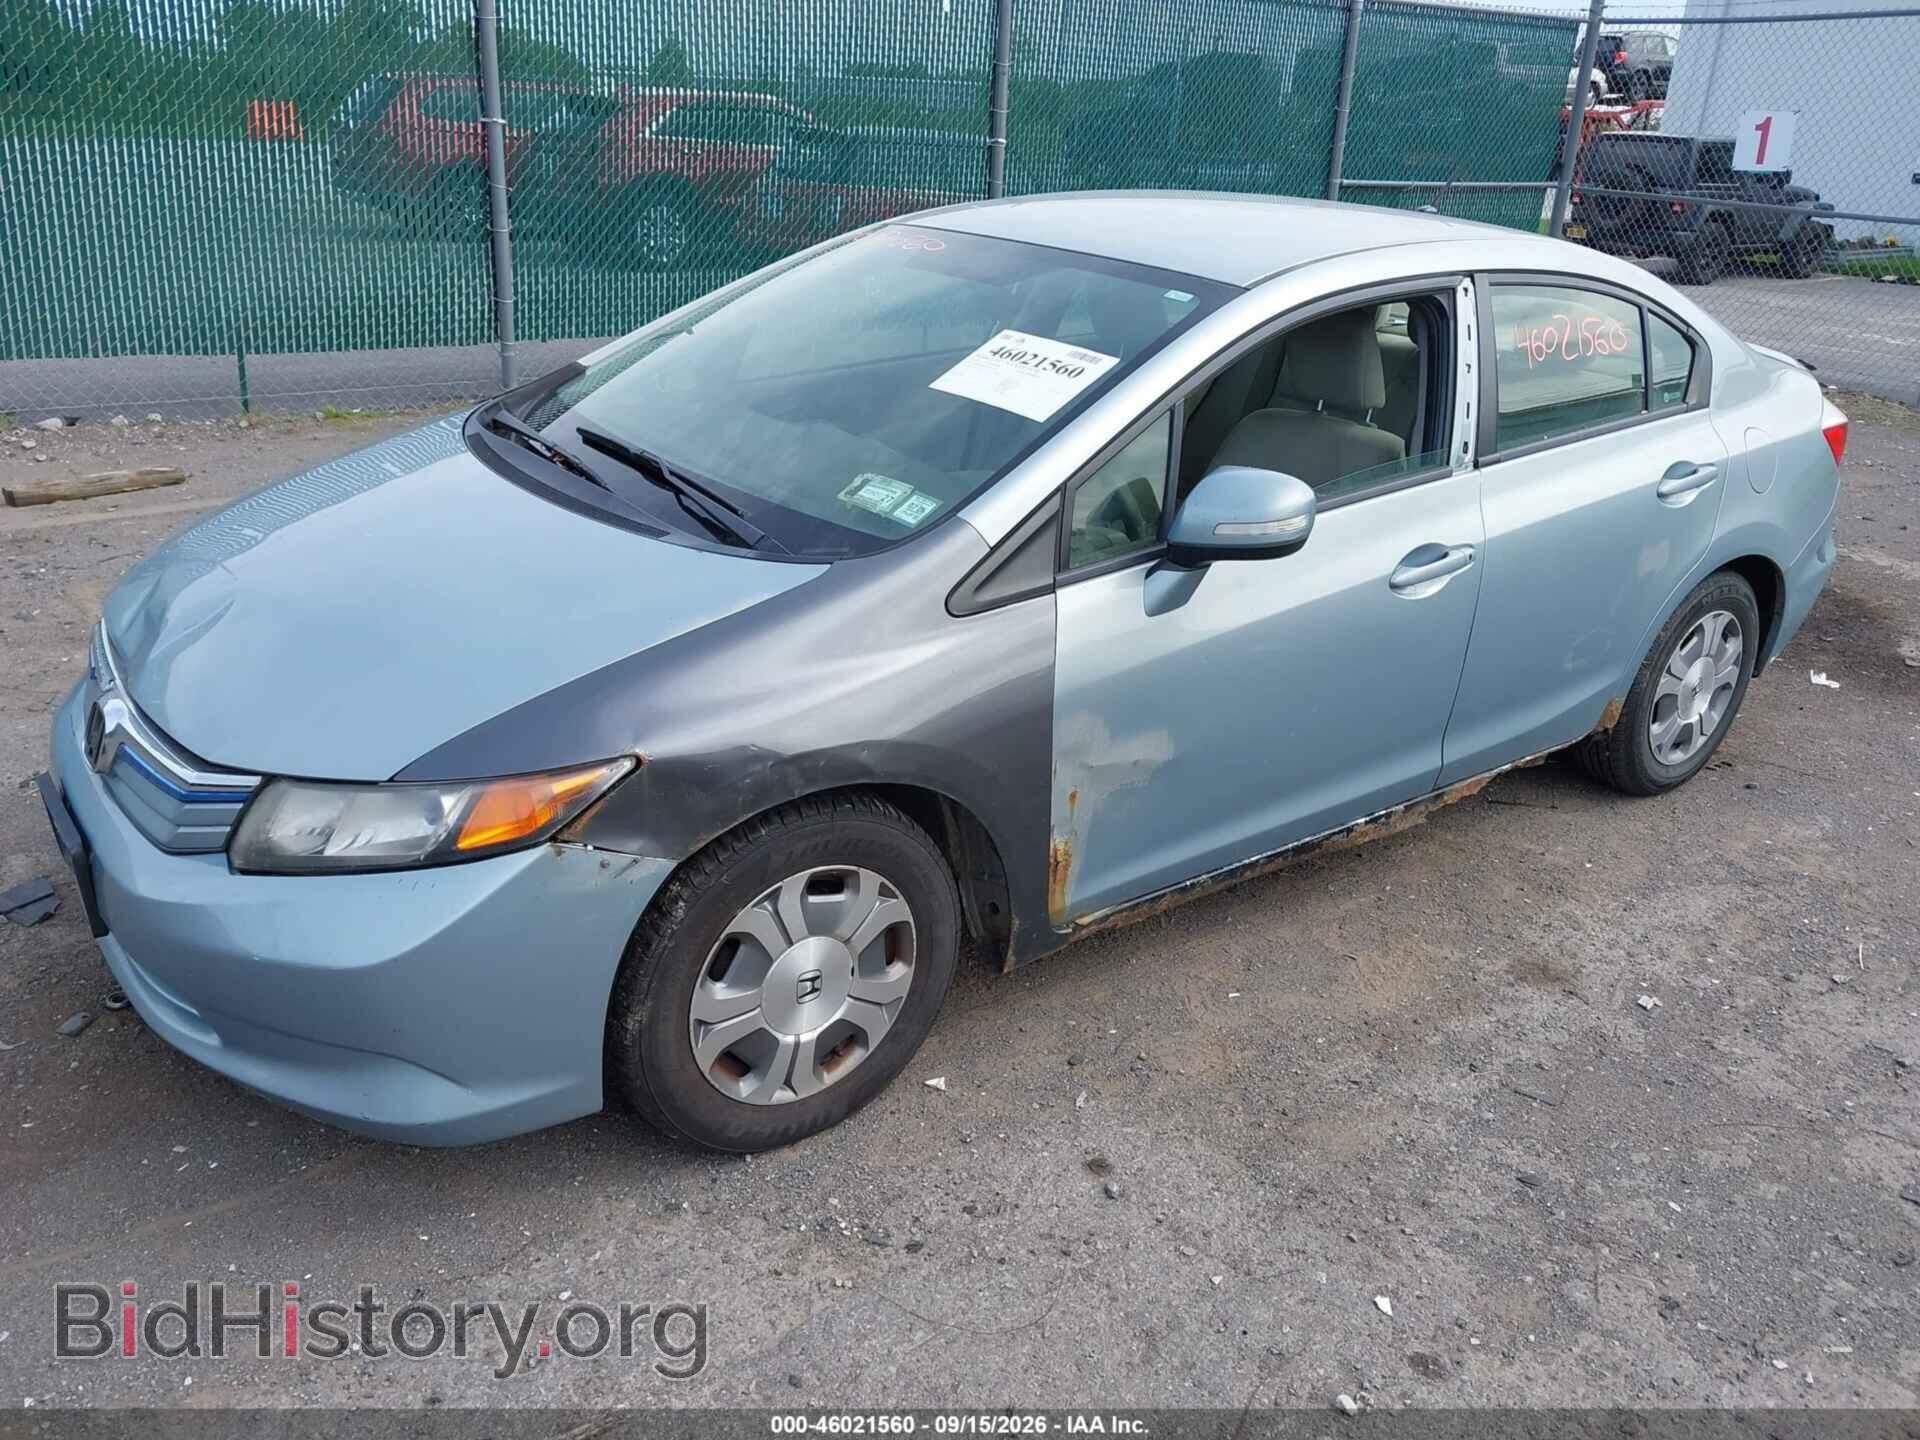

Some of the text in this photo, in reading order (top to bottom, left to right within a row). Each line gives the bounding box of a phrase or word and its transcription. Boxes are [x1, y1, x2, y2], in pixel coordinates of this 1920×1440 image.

[1754, 115, 1773, 166] 1
[989, 345, 1086, 379] 46021560
[1513, 313, 1629, 369] 46021560
